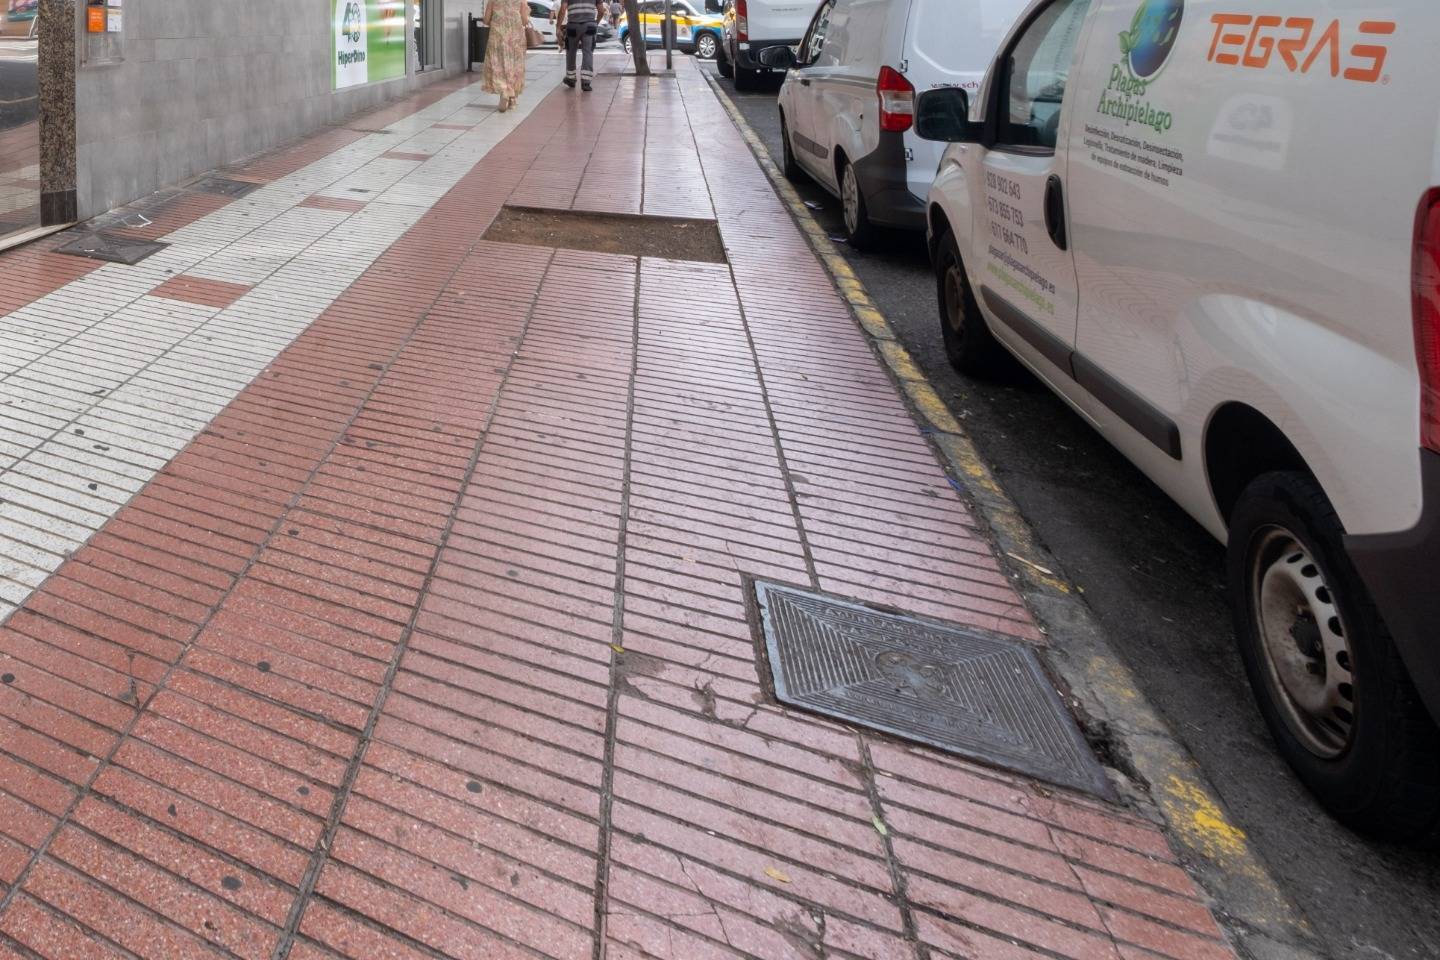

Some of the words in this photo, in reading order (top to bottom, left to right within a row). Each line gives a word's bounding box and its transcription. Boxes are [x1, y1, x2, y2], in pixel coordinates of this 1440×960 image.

[1207, 13, 1396, 83] TEGRAS
[1107, 63, 1146, 98] Plagas
[1096, 88, 1173, 134] Archipielago
